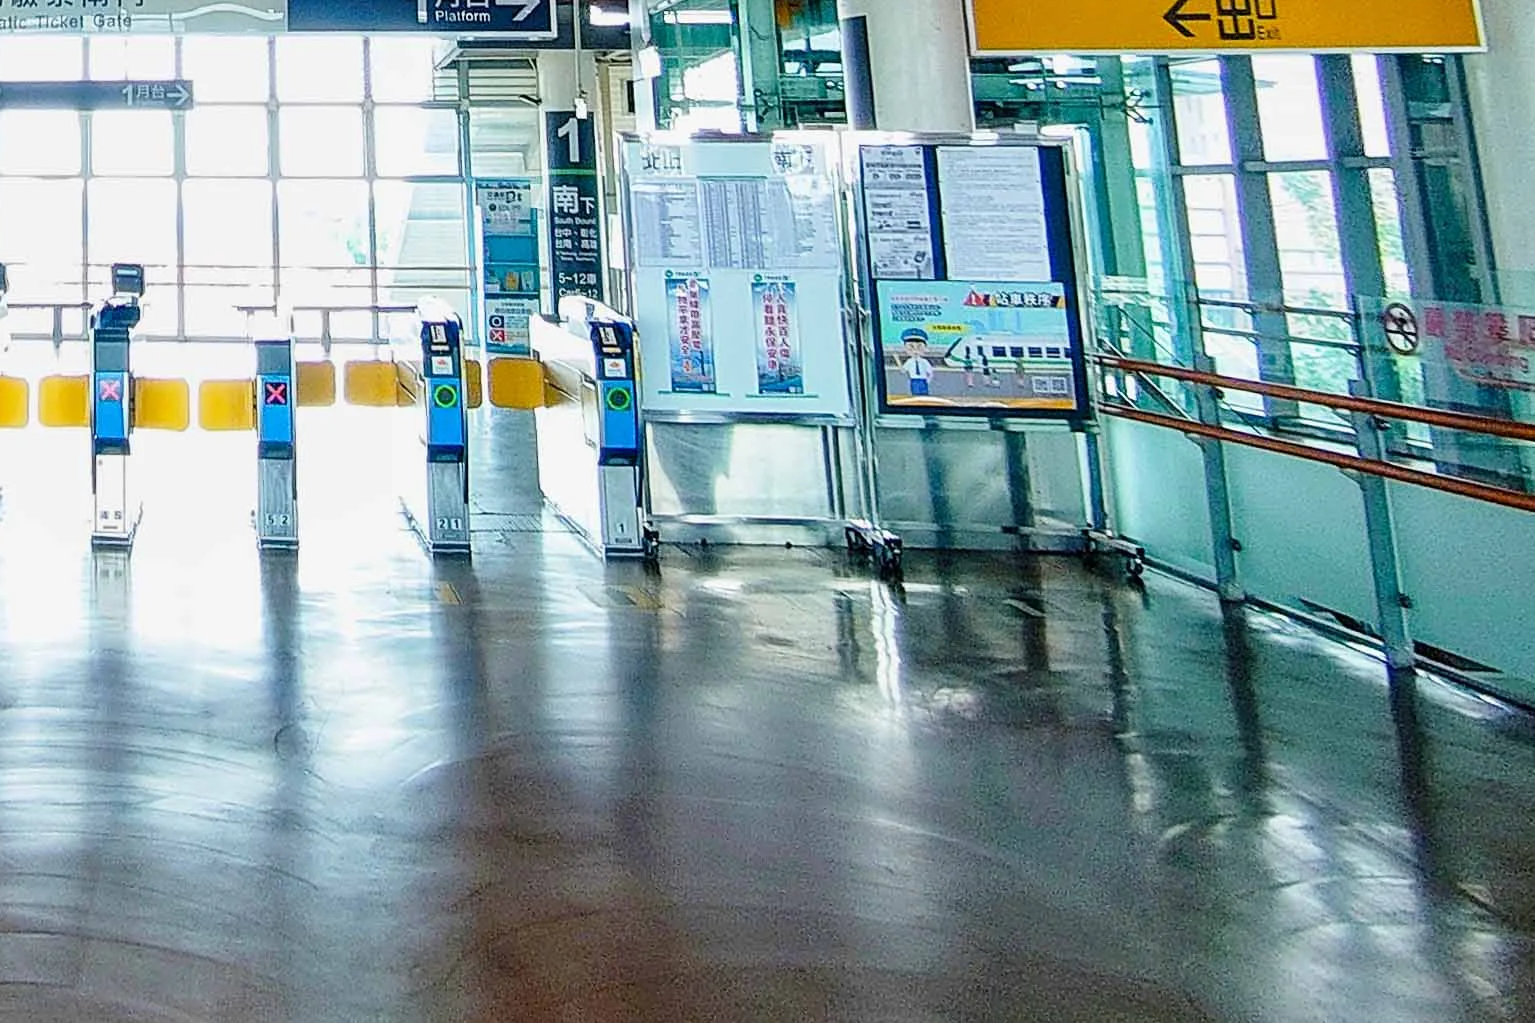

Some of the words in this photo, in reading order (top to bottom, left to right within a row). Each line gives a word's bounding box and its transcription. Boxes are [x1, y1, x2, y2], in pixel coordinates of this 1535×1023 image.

[36, 14, 84, 29] Ticket
[93, 13, 132, 28] Gate
[435, 9, 492, 23] Platform
[557, 117, 580, 163] 1
[552, 184, 595, 215] 南下
[100, 511, 108, 520] 4
[268, 516, 274, 525] 5
[281, 515, 289, 525] 2
[439, 519, 447, 529] 2
[453, 519, 460, 529] 1
[618, 523, 625, 533] 1
